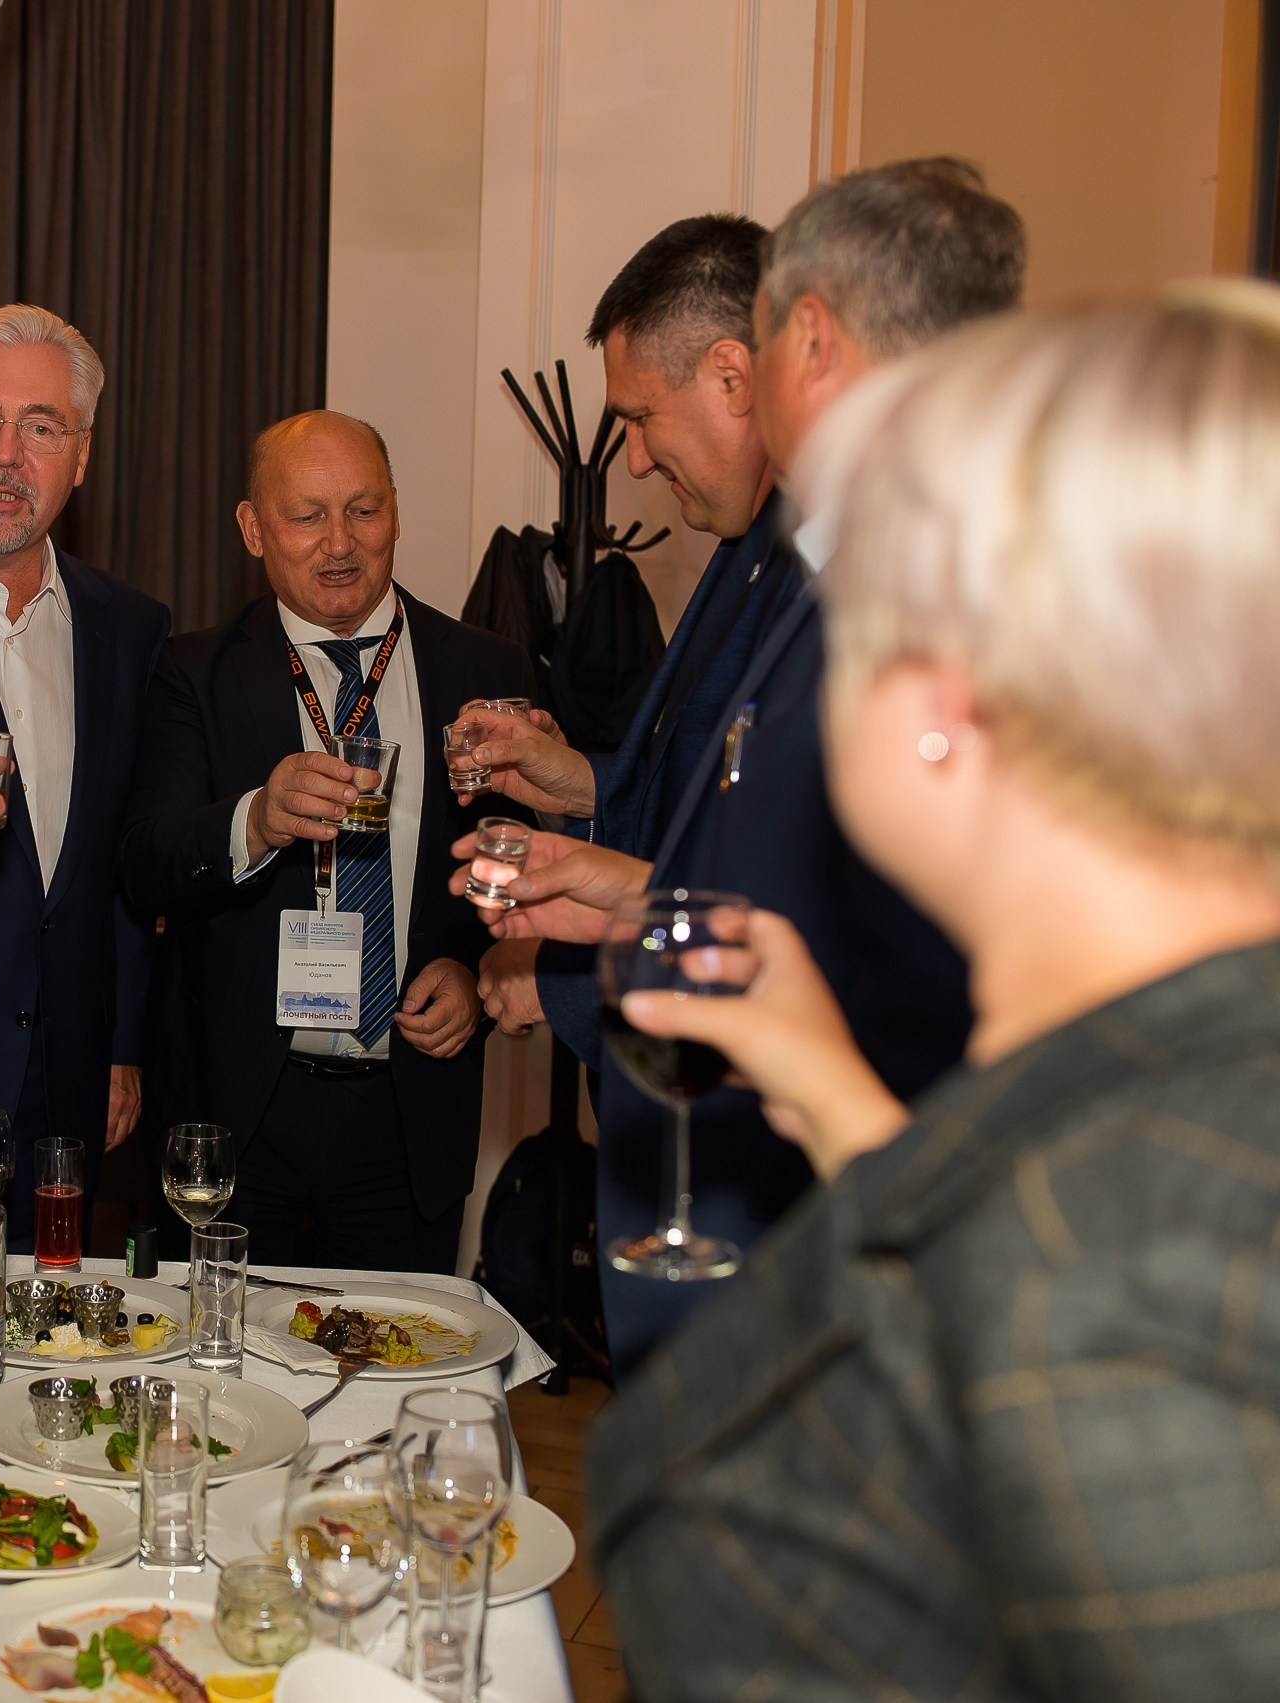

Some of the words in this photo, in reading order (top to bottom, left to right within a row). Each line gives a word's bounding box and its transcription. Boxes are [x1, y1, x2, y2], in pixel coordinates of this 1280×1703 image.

[372, 631, 398, 681] BOWA
[303, 692, 330, 746] BOWA
[343, 695, 372, 736] OWA
[288, 921, 307, 934] VIII
[283, 1011, 327, 1019] ПОЧЕТНЫЙ
[328, 1013, 353, 1021] ГОСТЬ
